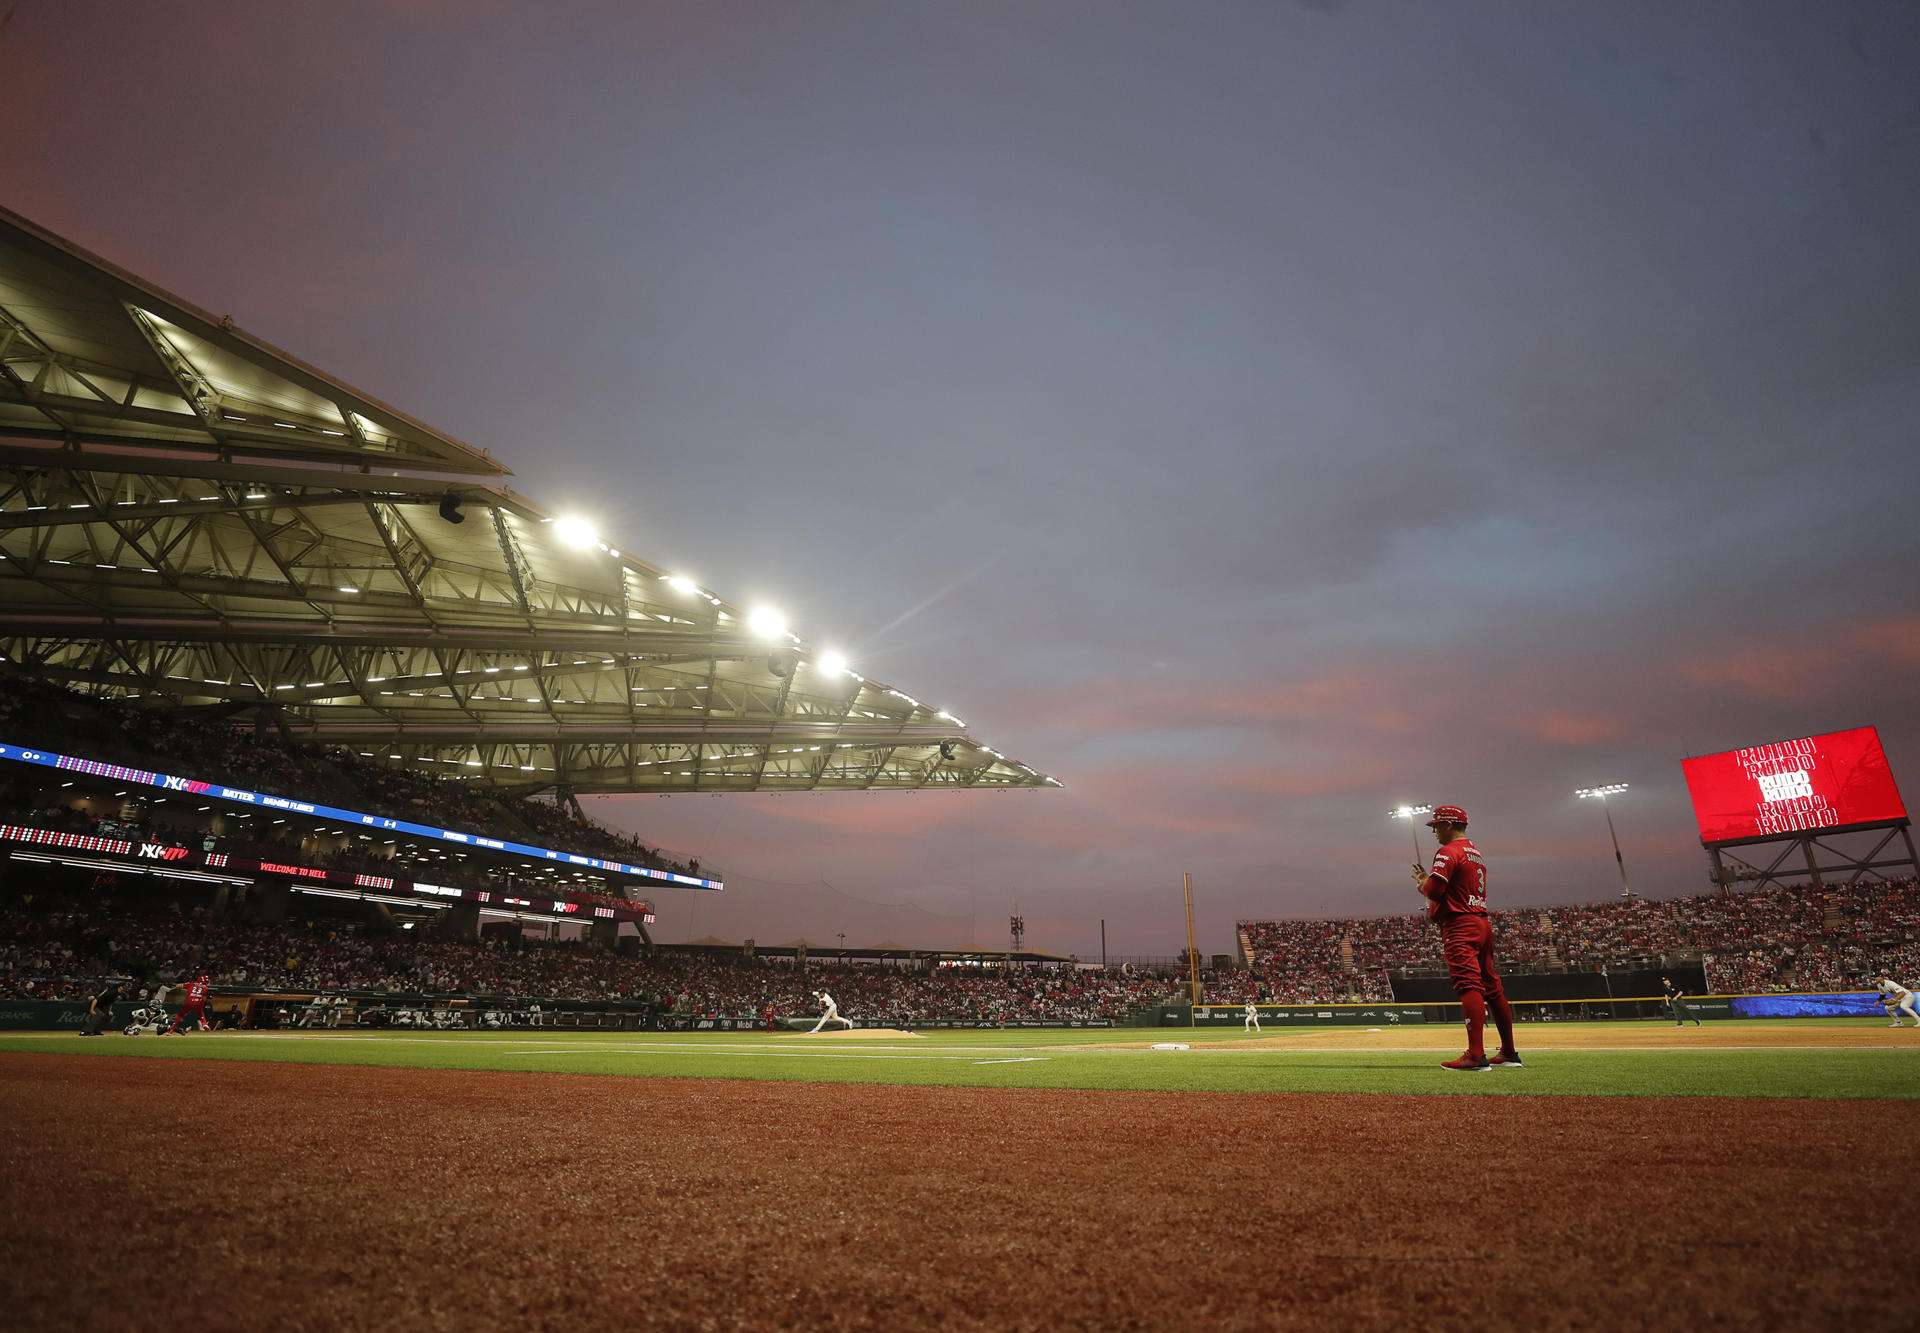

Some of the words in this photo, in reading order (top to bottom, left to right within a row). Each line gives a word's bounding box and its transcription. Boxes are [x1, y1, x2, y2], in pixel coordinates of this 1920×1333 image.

[260, 862, 298, 875] WELCOME
[299, 867, 308, 876] TO
[736, 1020, 754, 1029] Mobil
